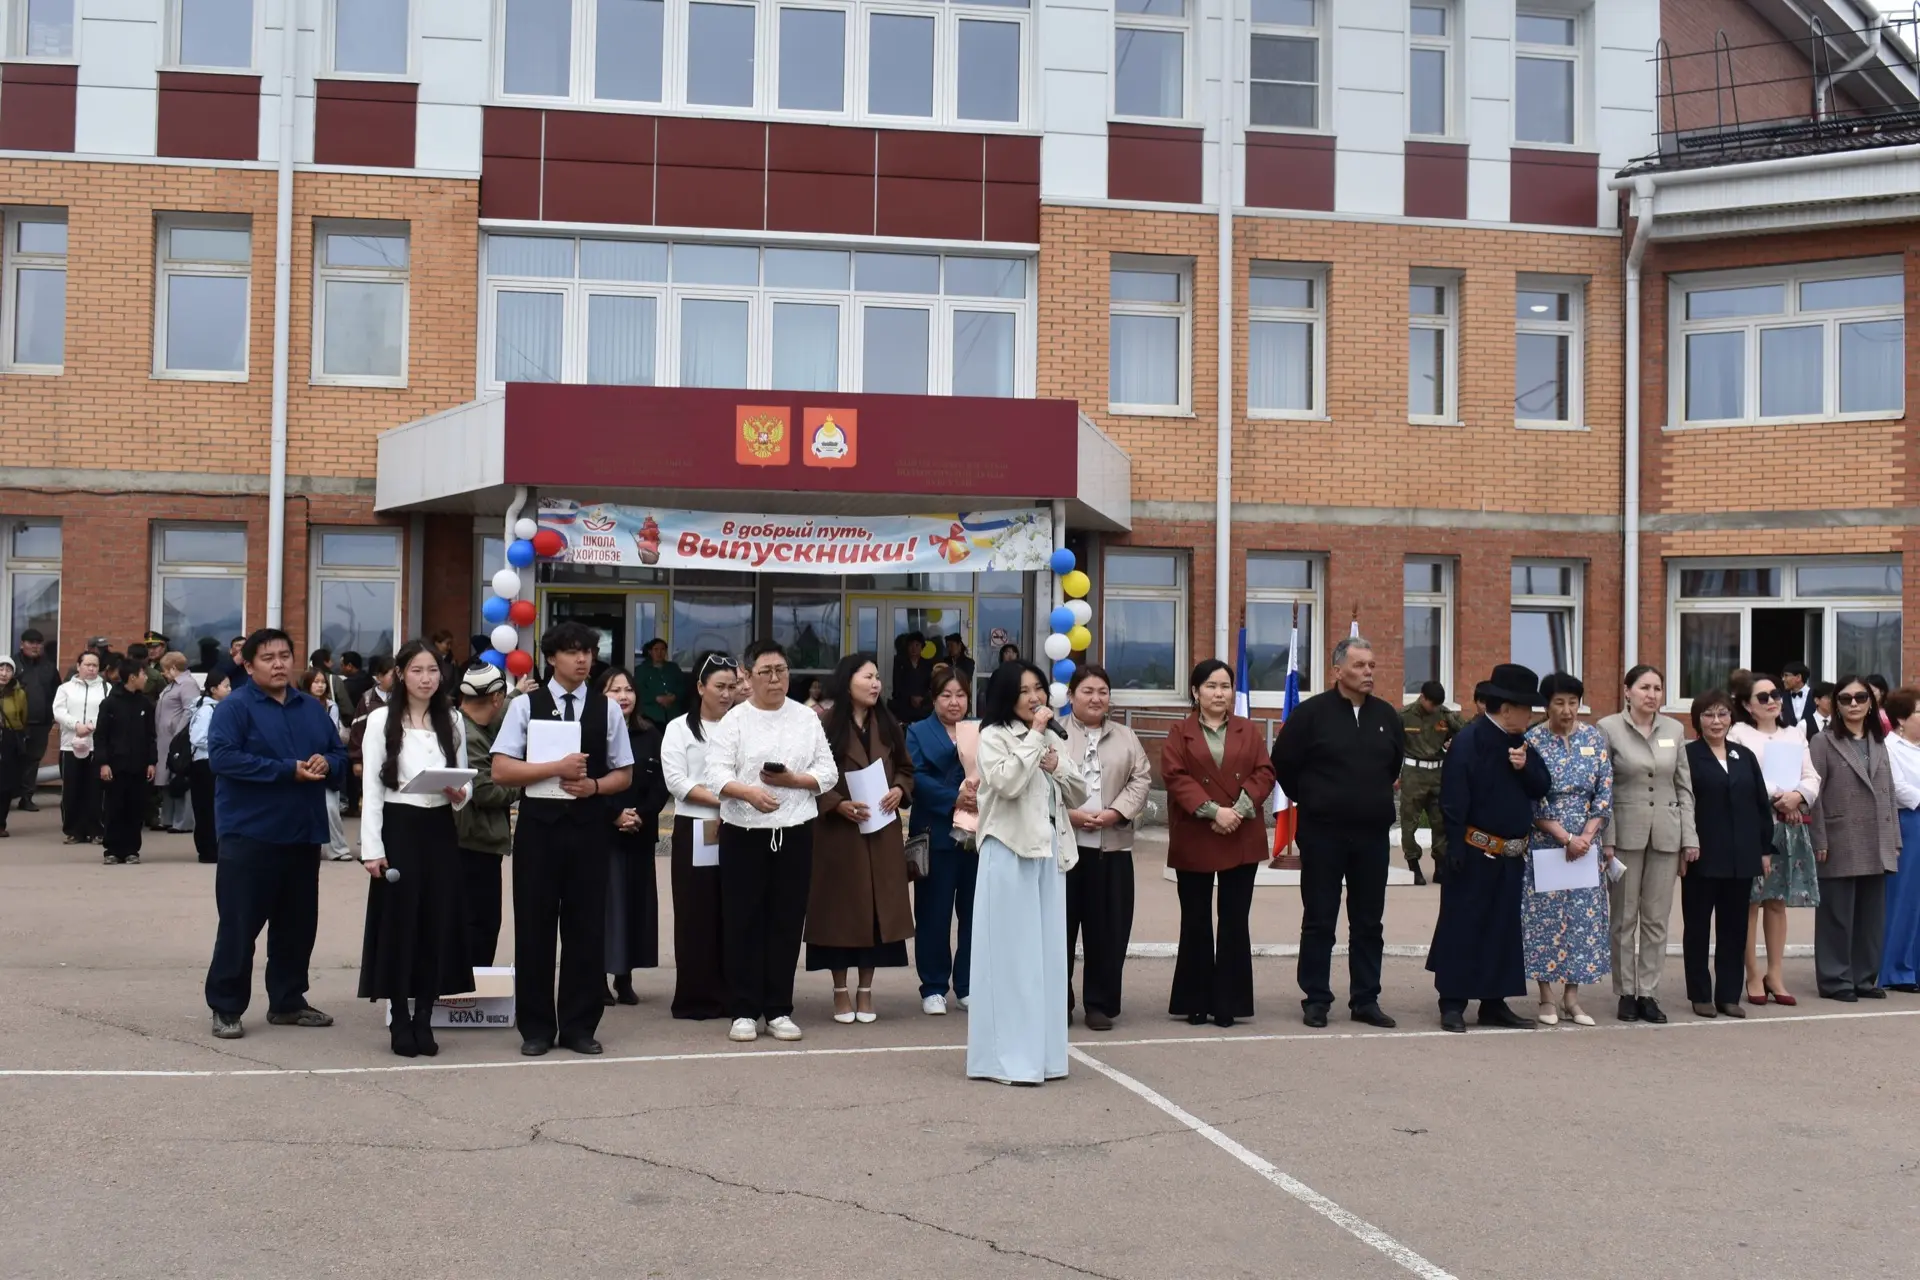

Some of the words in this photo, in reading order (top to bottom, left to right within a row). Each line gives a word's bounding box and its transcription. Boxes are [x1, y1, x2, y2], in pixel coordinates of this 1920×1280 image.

[722, 521, 736, 536] В
[738, 521, 813, 540] добрый
[816, 526, 873, 541] путь,
[583, 535, 615, 548] ШКОЛА
[677, 532, 918, 567] Выпускники!
[576, 548, 621, 562] ХОЙТОБЭЕ
[448, 1008, 484, 1024] КРАБ
